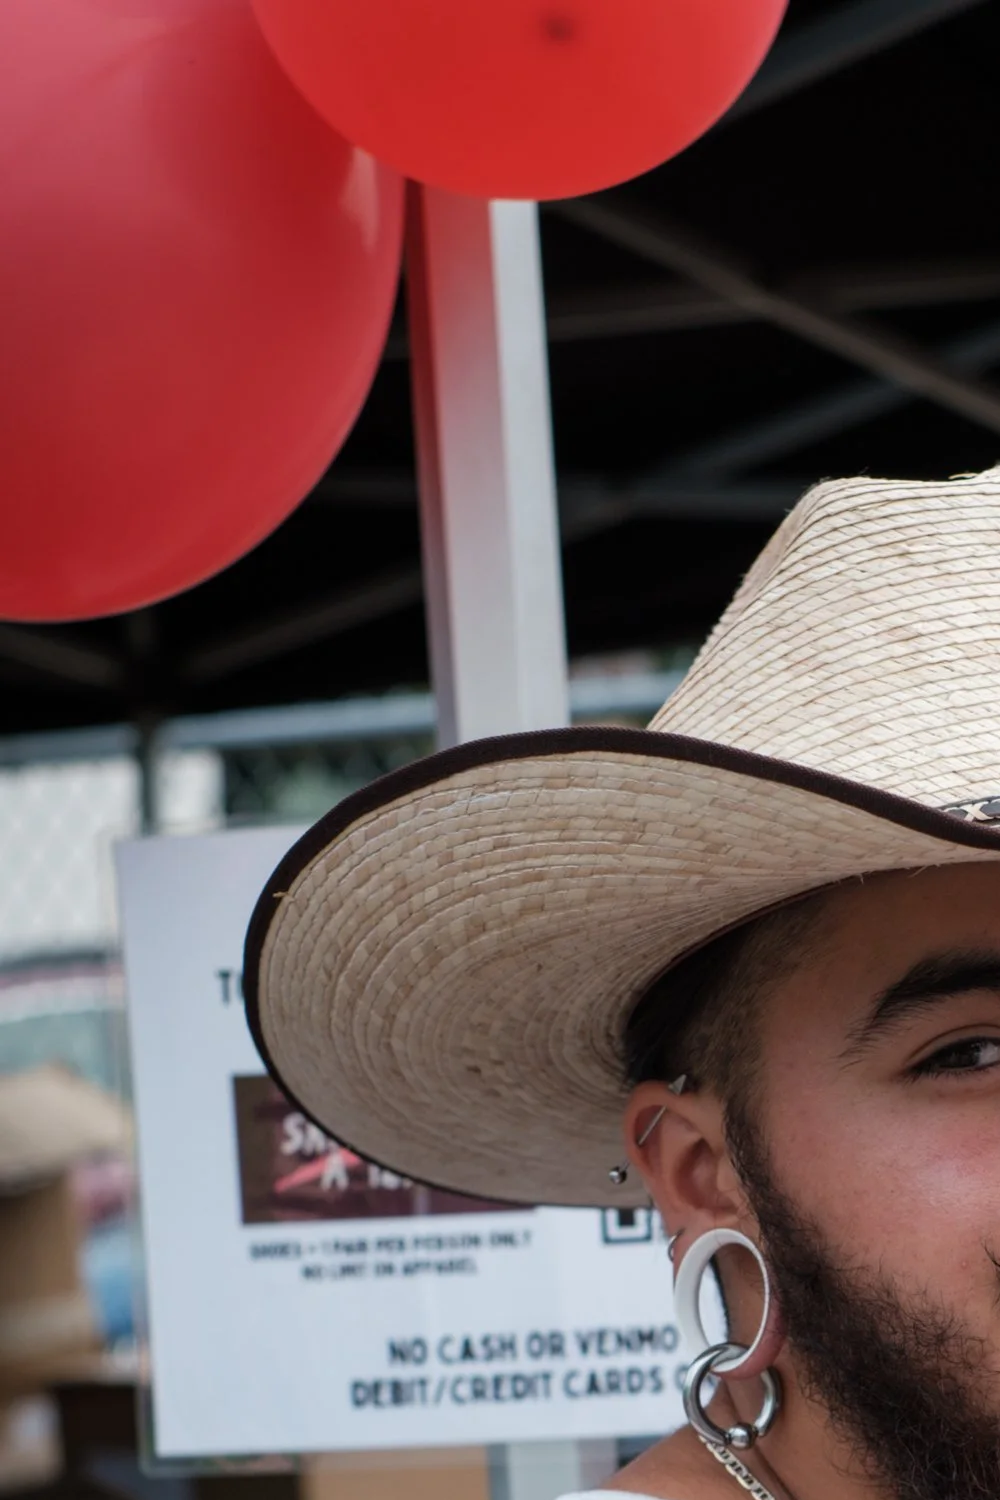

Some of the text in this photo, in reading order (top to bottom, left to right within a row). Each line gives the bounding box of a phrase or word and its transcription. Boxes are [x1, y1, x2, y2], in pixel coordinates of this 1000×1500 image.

[388, 1325, 679, 1364] NO CASH OR VENMO
[350, 1373, 554, 1409] DEBIT/CREDIT
[563, 1366, 664, 1396] CARDS
